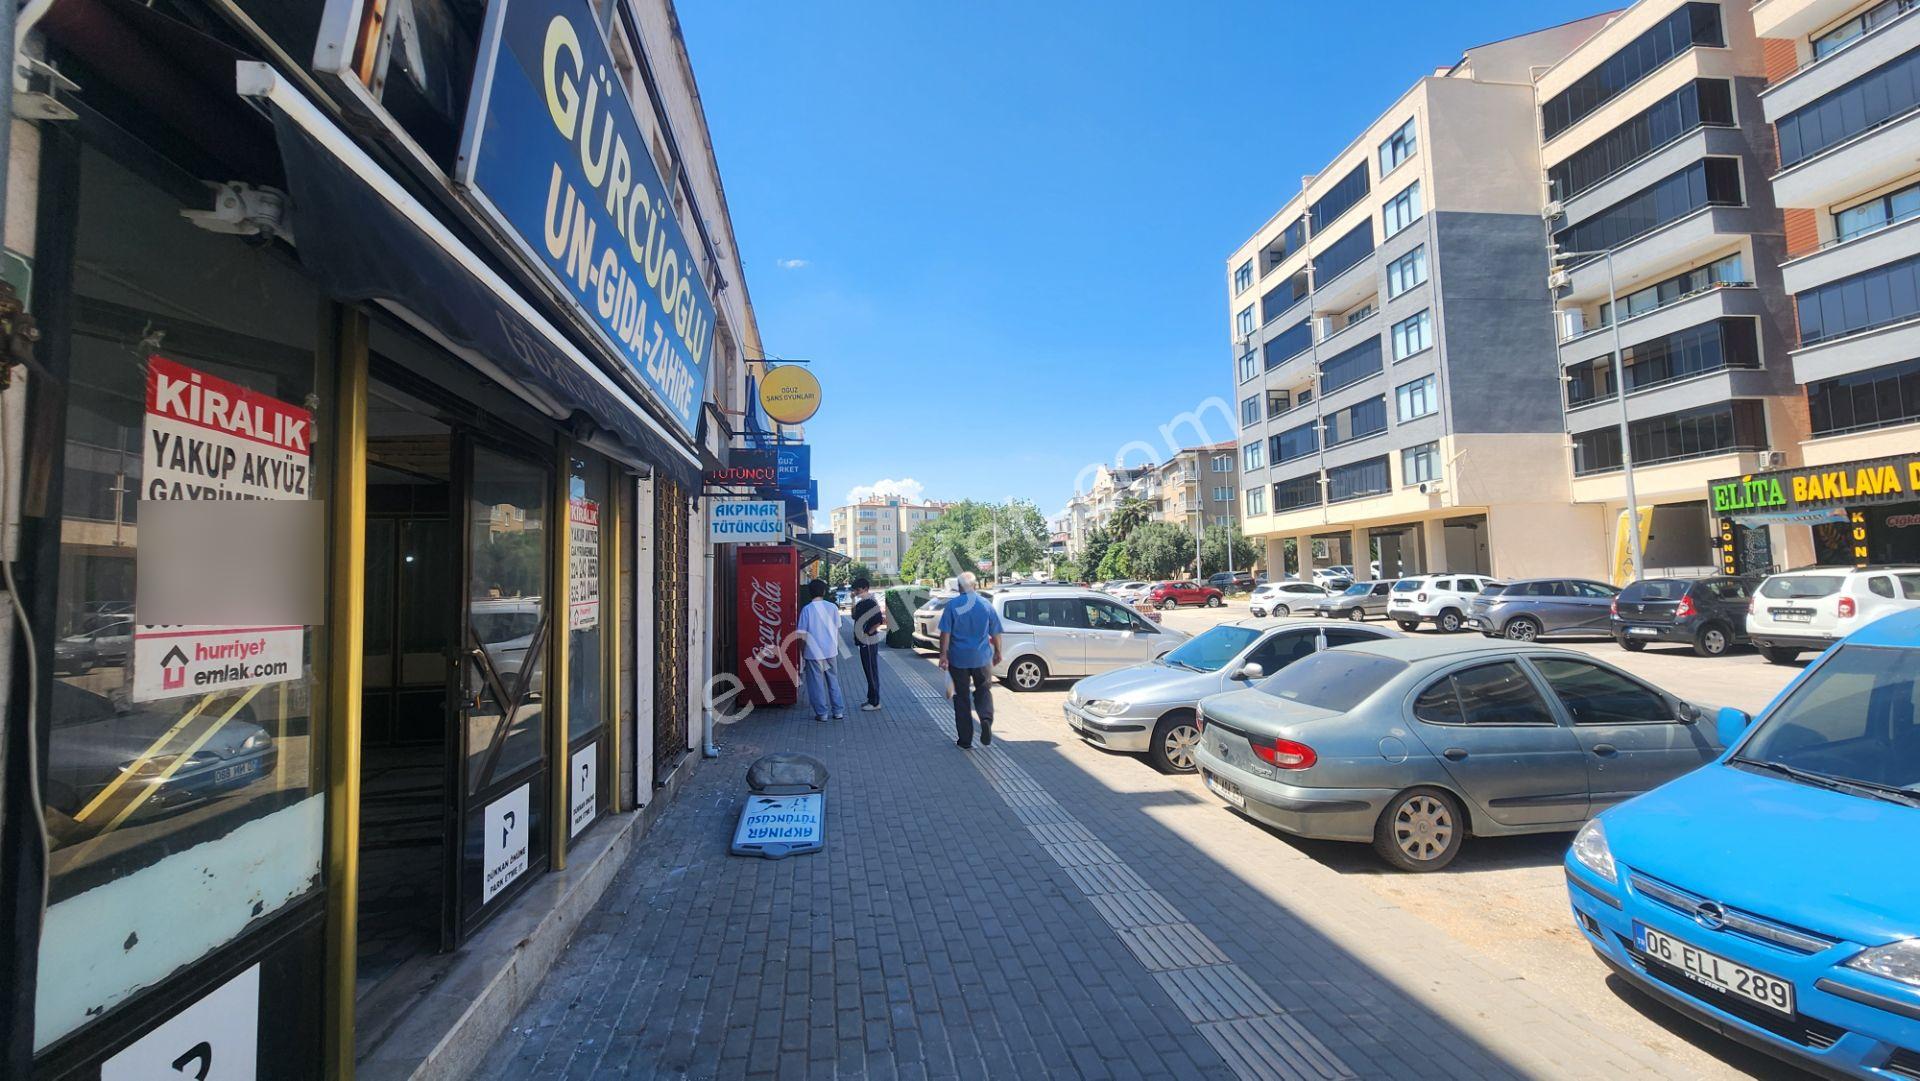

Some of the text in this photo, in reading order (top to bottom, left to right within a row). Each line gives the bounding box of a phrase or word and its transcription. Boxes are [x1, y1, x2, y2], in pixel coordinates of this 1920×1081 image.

[543, 15, 707, 364] GÜRCÜOĞLU
[156, 373, 306, 451] KİRALIK
[153, 429, 235, 480] YAKUP
[242, 453, 305, 495] AKYÜZ
[777, 457, 794, 465] ĞUZ
[779, 465, 799, 473] RKET
[1712, 474, 1786, 511] ELİTA
[1792, 465, 1902, 502] BAKLAVA
[715, 503, 779, 517] AKPINAR
[712, 519, 783, 534] TÜTÜNCÜSÜ
[1851, 512, 1868, 568] KÜN
[752, 576, 782, 669] Coca-Cola
[195, 638, 266, 662] hurriyet
[194, 661, 288, 686] emlak.com
[747, 814, 817, 825] TÜTÜNCÜSÜ
[748, 827, 813, 839] AKPINAR
[1646, 931, 1787, 1008] 06 ELL 289
